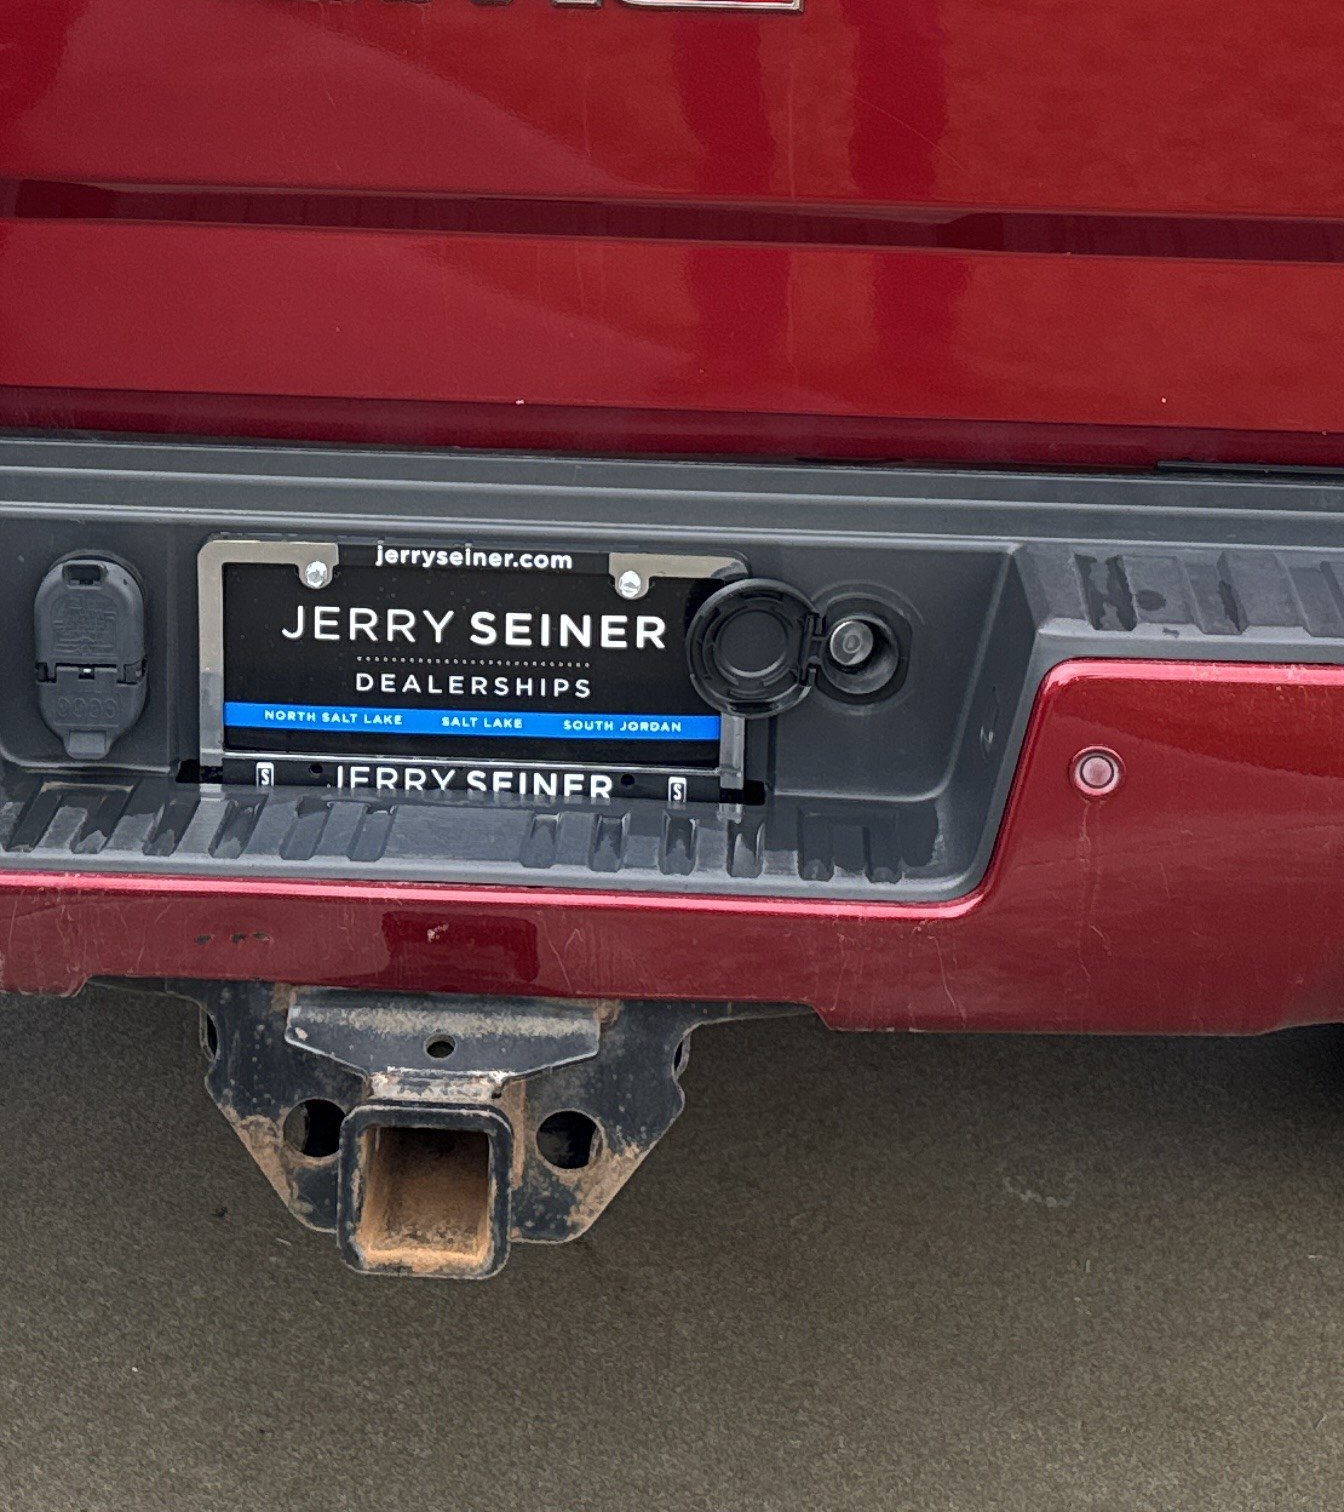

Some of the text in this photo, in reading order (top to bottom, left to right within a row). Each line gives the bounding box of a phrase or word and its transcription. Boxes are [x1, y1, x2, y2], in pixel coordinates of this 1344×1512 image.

[375, 540, 574, 570] jerryseiner.com
[281, 605, 667, 650] JERRY SEINER
[355, 672, 592, 699] DEALERSHIPS
[263, 709, 403, 726] NORTH SALT LAKE
[441, 716, 524, 729] SALT LAKE
[563, 719, 683, 733] SOUTH JORDAN
[467, 770, 614, 799] SEINER
